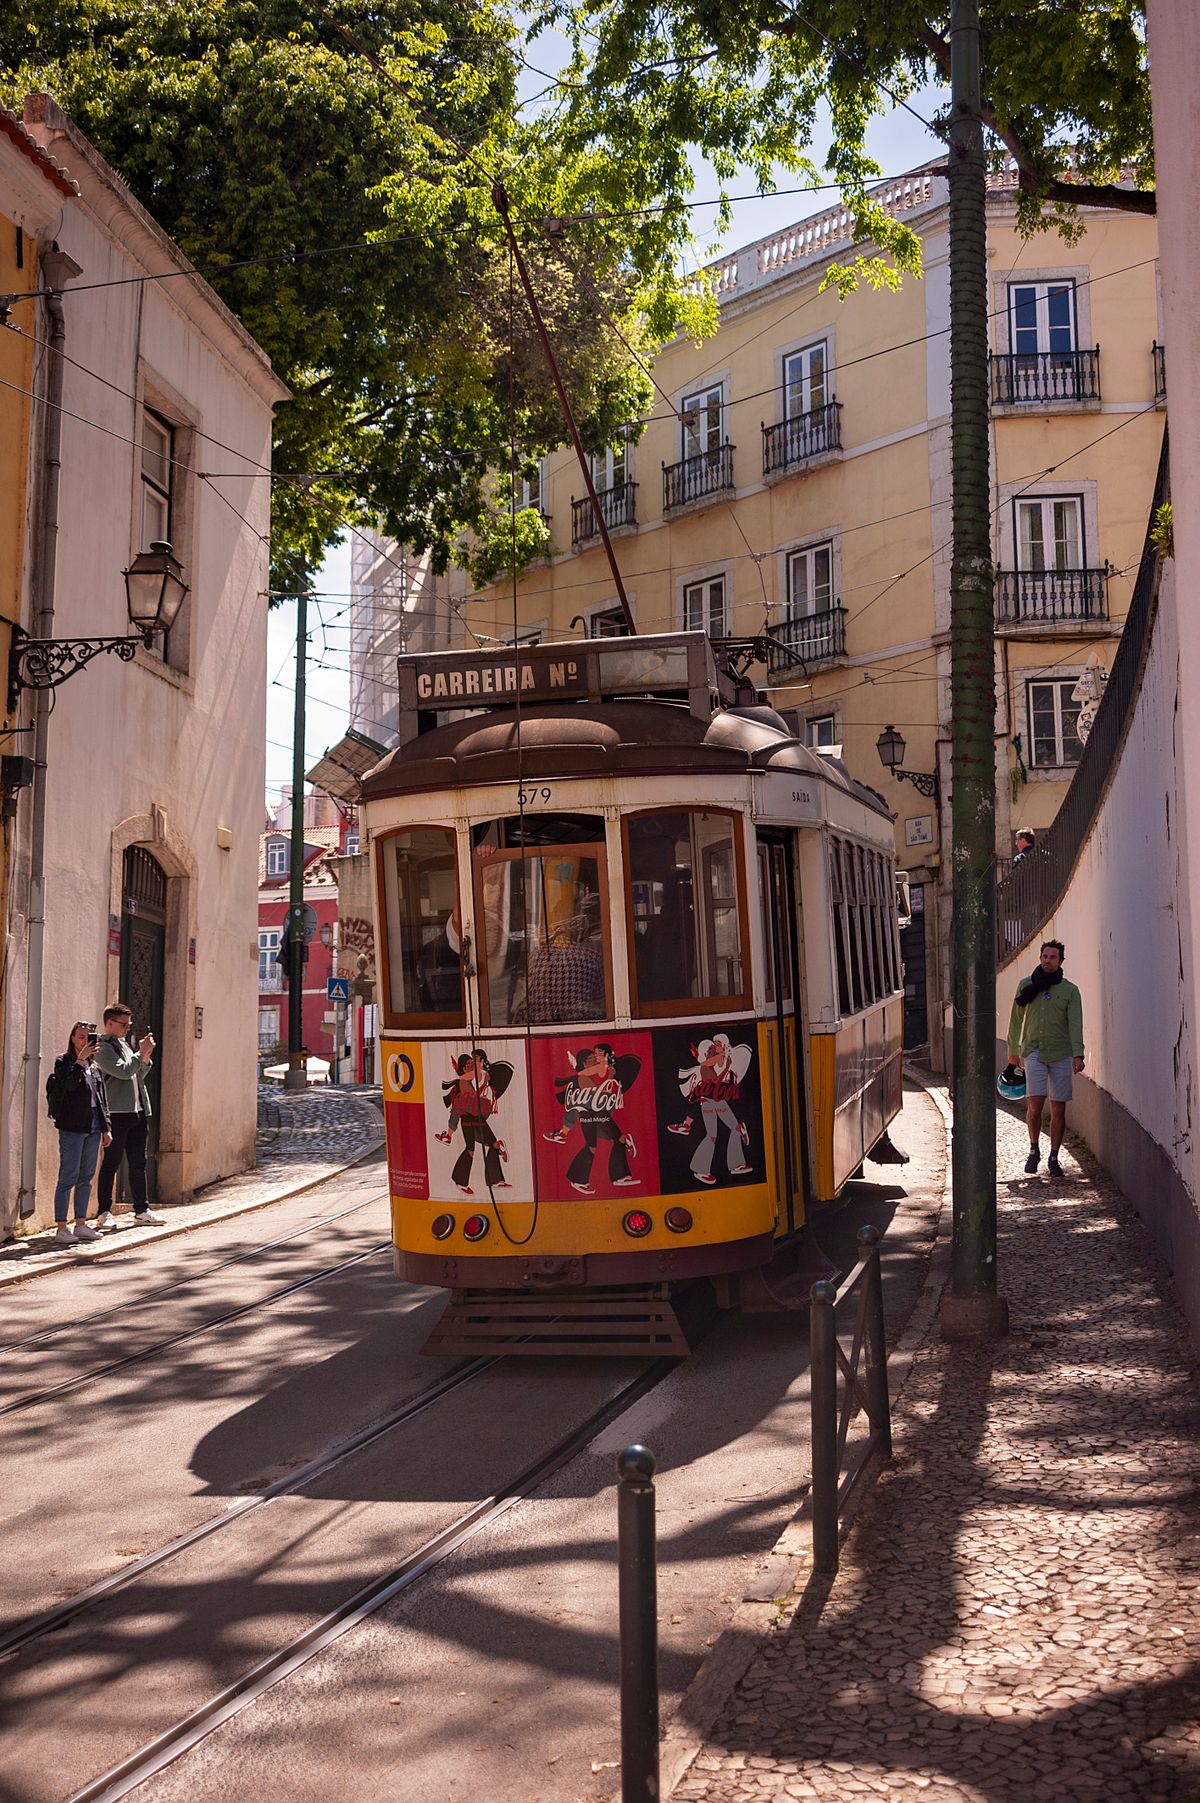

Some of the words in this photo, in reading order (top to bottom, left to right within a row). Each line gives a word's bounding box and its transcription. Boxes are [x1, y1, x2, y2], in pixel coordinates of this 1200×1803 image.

[417, 665, 536, 699] CARREIRA
[517, 787, 552, 805] 579
[564, 1078, 625, 1112] Coca-Cola
